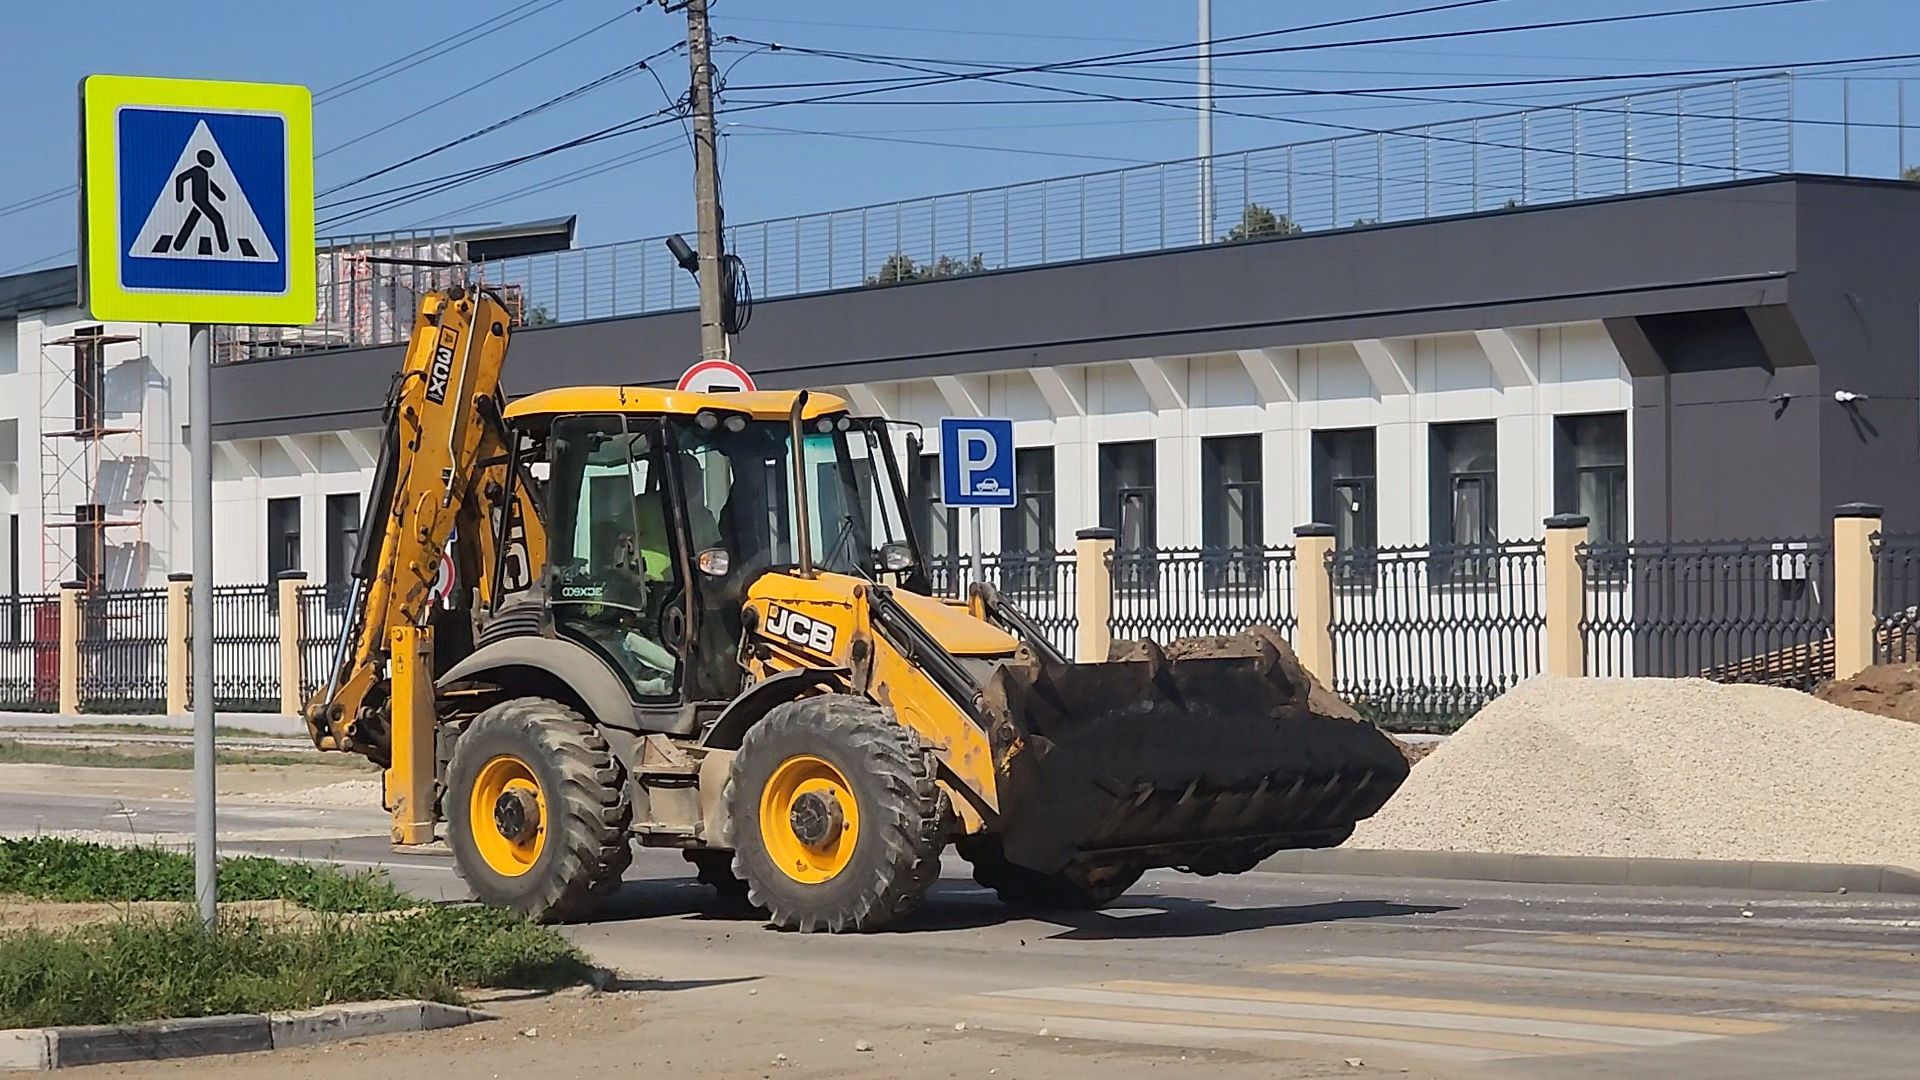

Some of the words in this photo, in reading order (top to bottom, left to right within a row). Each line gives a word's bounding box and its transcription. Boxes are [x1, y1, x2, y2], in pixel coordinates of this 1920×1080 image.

[428, 347, 452, 396] 3CX
[957, 428, 997, 496] P
[766, 609, 834, 653] JCB
